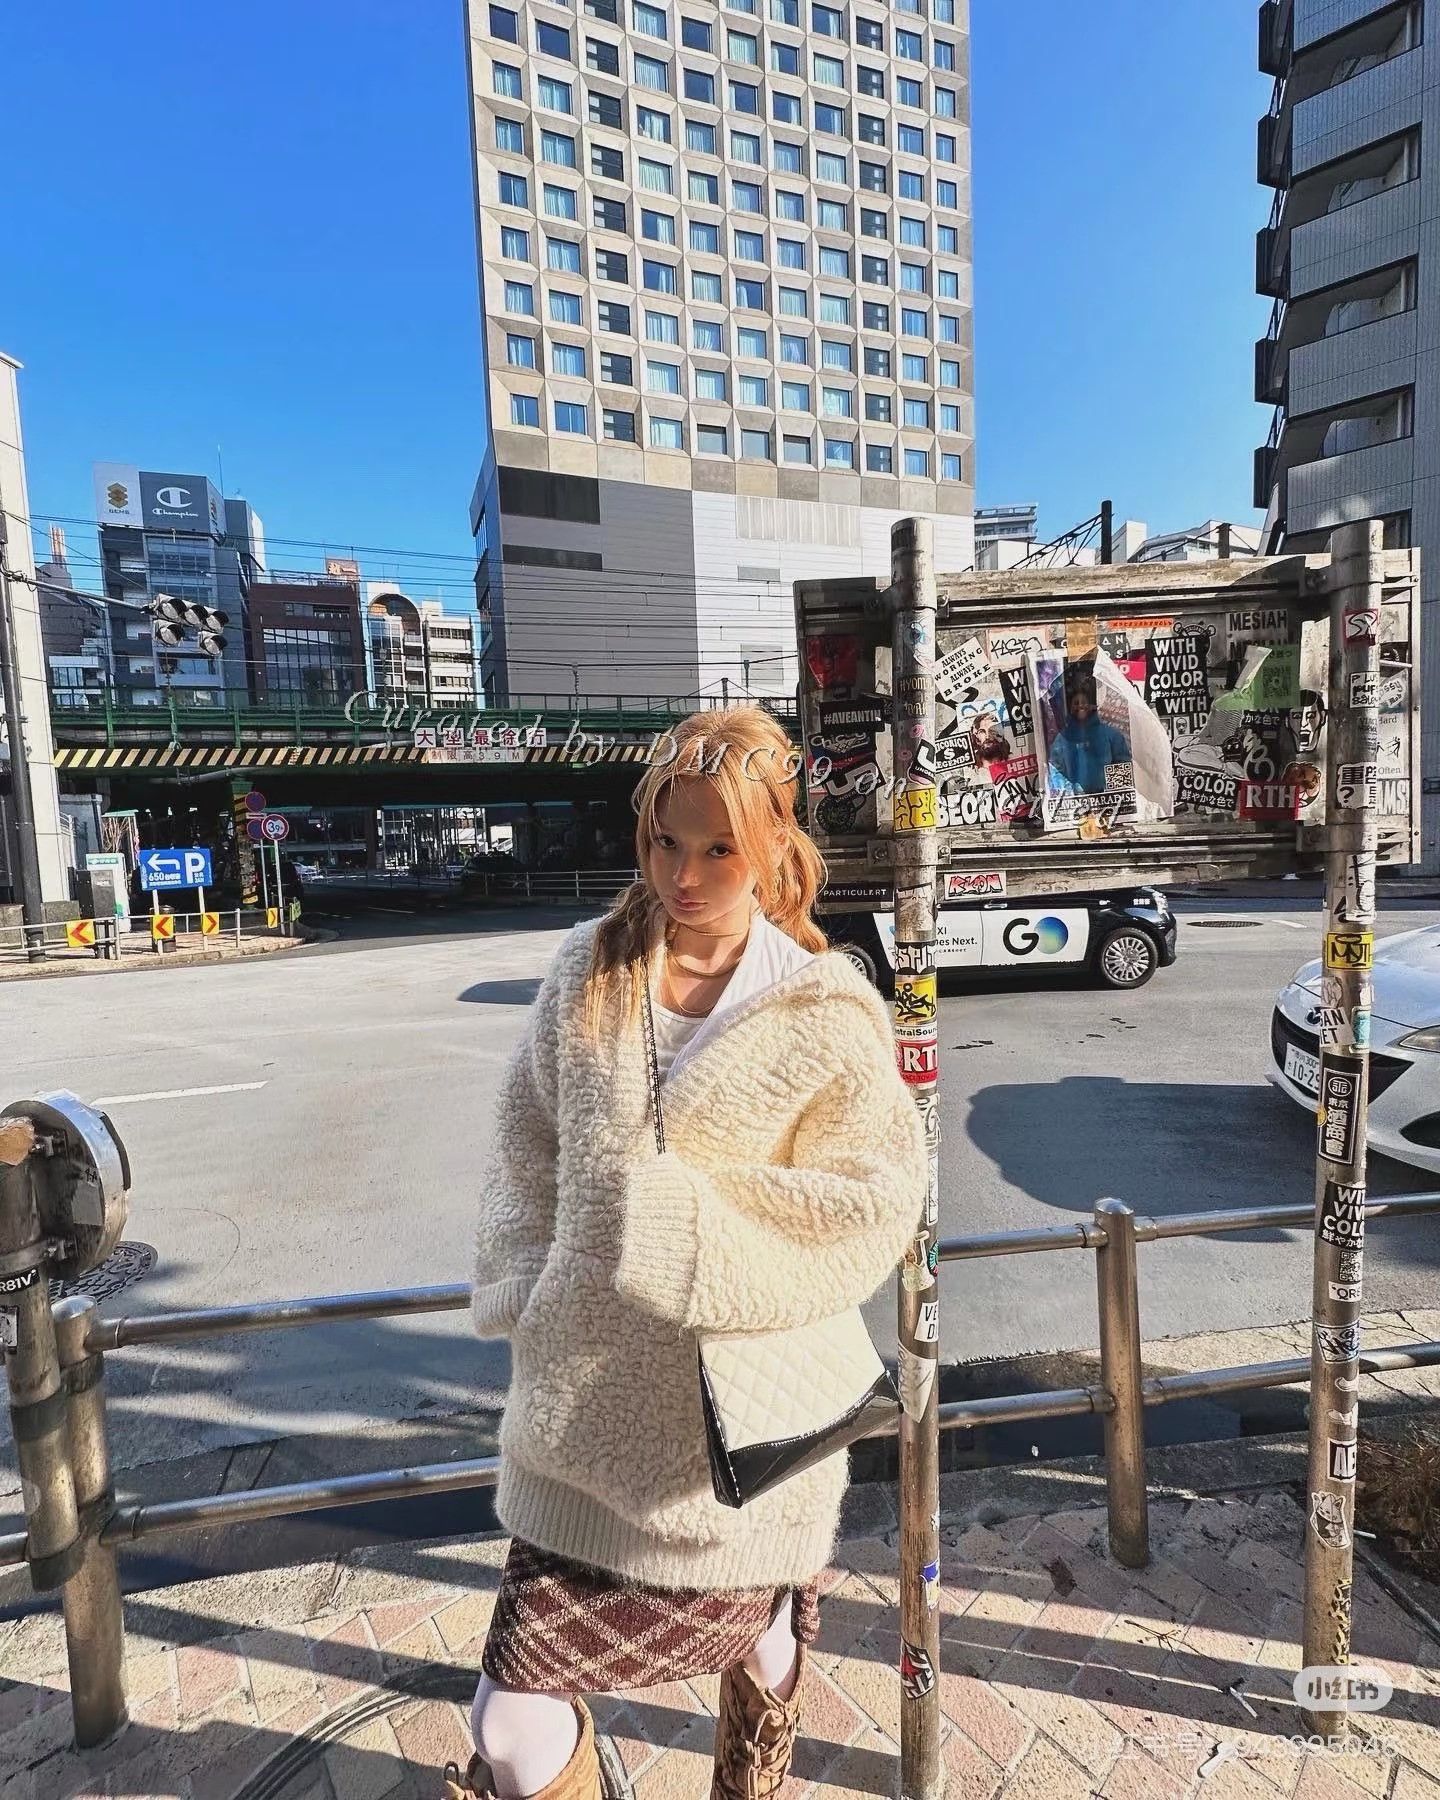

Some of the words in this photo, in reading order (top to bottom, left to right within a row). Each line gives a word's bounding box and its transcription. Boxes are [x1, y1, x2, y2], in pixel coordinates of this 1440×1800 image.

[1230, 611, 1288, 631] MESIAH
[1153, 637, 1196, 656] WITH
[934, 647, 983, 681] WORKING
[941, 648, 967, 668] ALWAYS
[1153, 654, 1199, 673] VIVID
[943, 663, 991, 697] BROKE
[950, 663, 976, 683] ALWAYS
[1149, 671, 1204, 690] COLOR
[1164, 695, 1207, 714] WITH
[936, 752, 971, 769] EGENDS
[1183, 775, 1236, 797] COLOR
[1181, 790, 1234, 807] 鮮やかな色で
[184, 852, 206, 884] P
[952, 937, 978, 946] Next.
